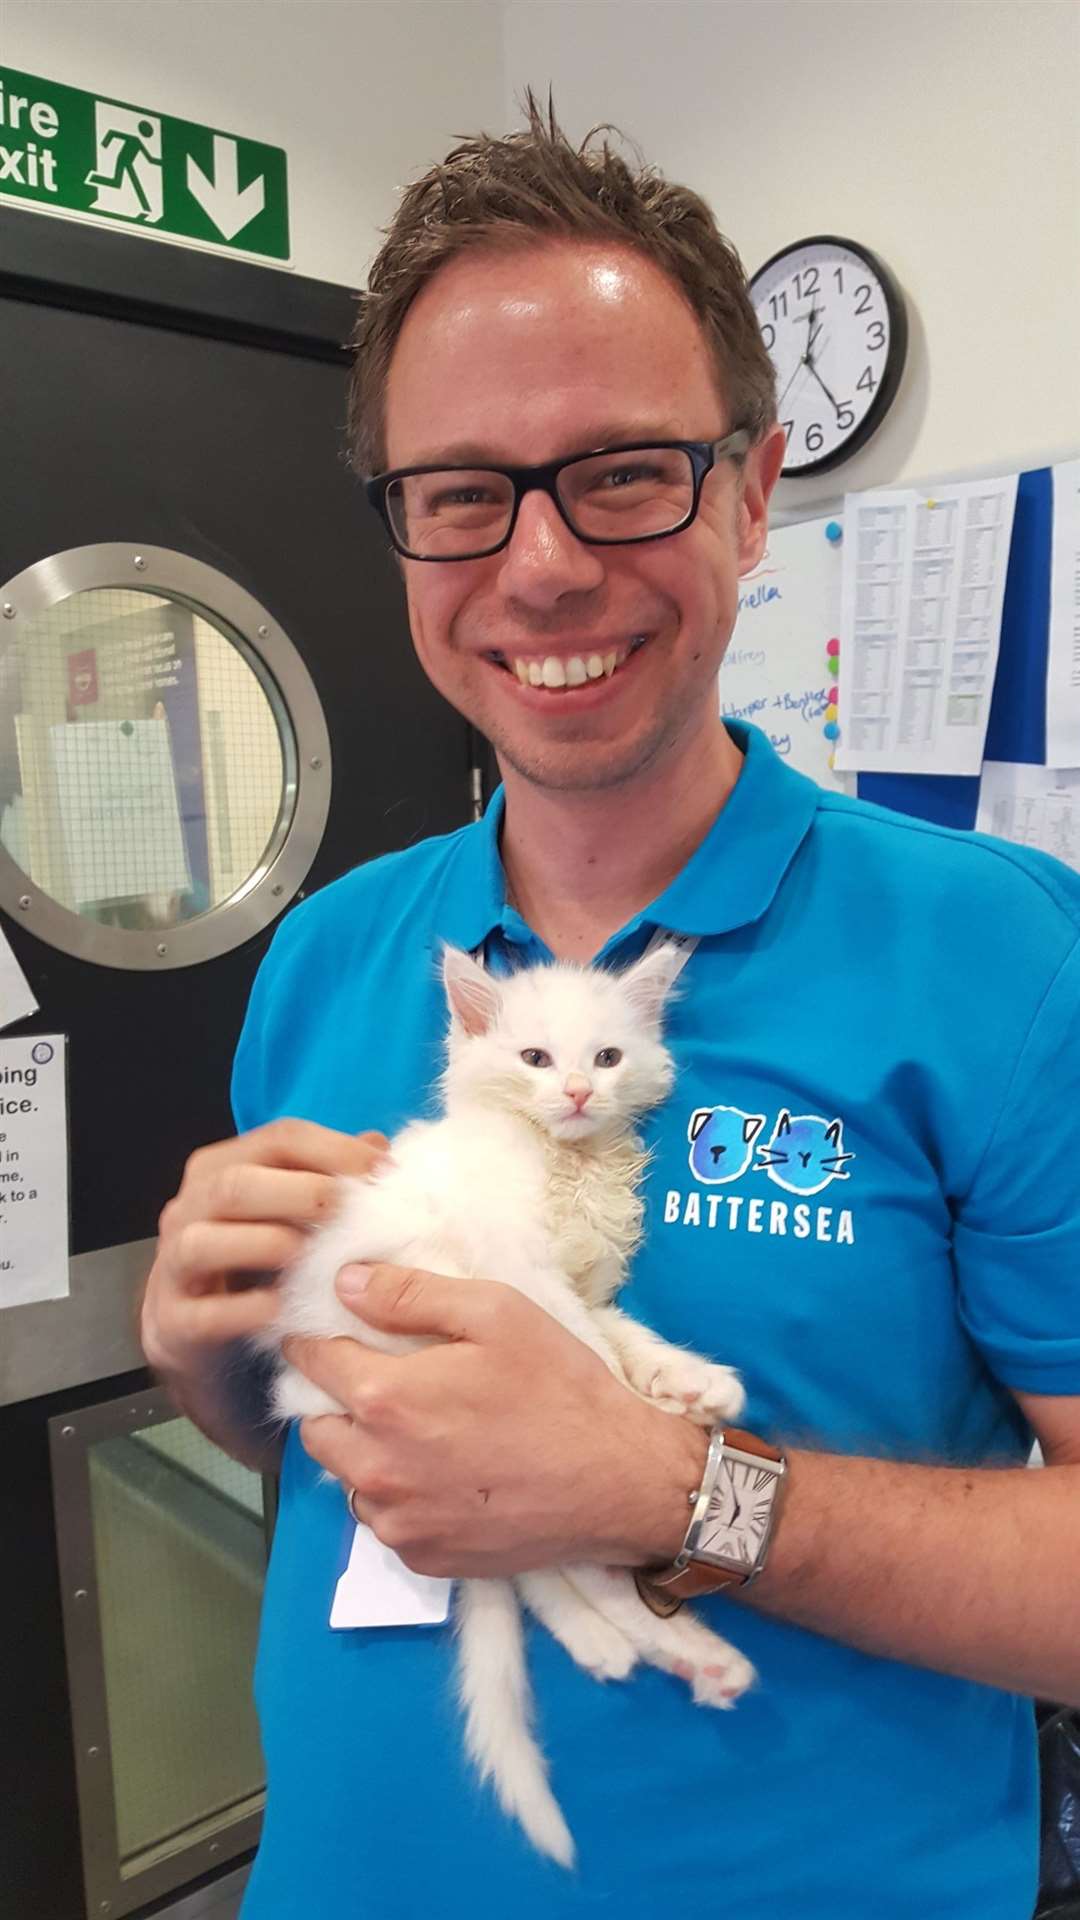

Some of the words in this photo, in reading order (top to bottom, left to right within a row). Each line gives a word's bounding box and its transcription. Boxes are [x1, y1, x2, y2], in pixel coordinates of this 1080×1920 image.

[0, 142, 58, 192] xit
[792, 268, 820, 300] 12
[833, 267, 843, 294] 1
[769, 291, 788, 320] 11
[854, 285, 873, 315] 2
[761, 324, 776, 350] 0
[866, 321, 885, 350] 3
[856, 366, 877, 392] 4
[836, 400, 855, 429] 5
[806, 424, 824, 451] 6
[6, 1150, 20, 1162] in
[11, 1190, 25, 1202] to
[28, 1189, 38, 1199] a
[664, 1190, 855, 1244] BATTERSEA
